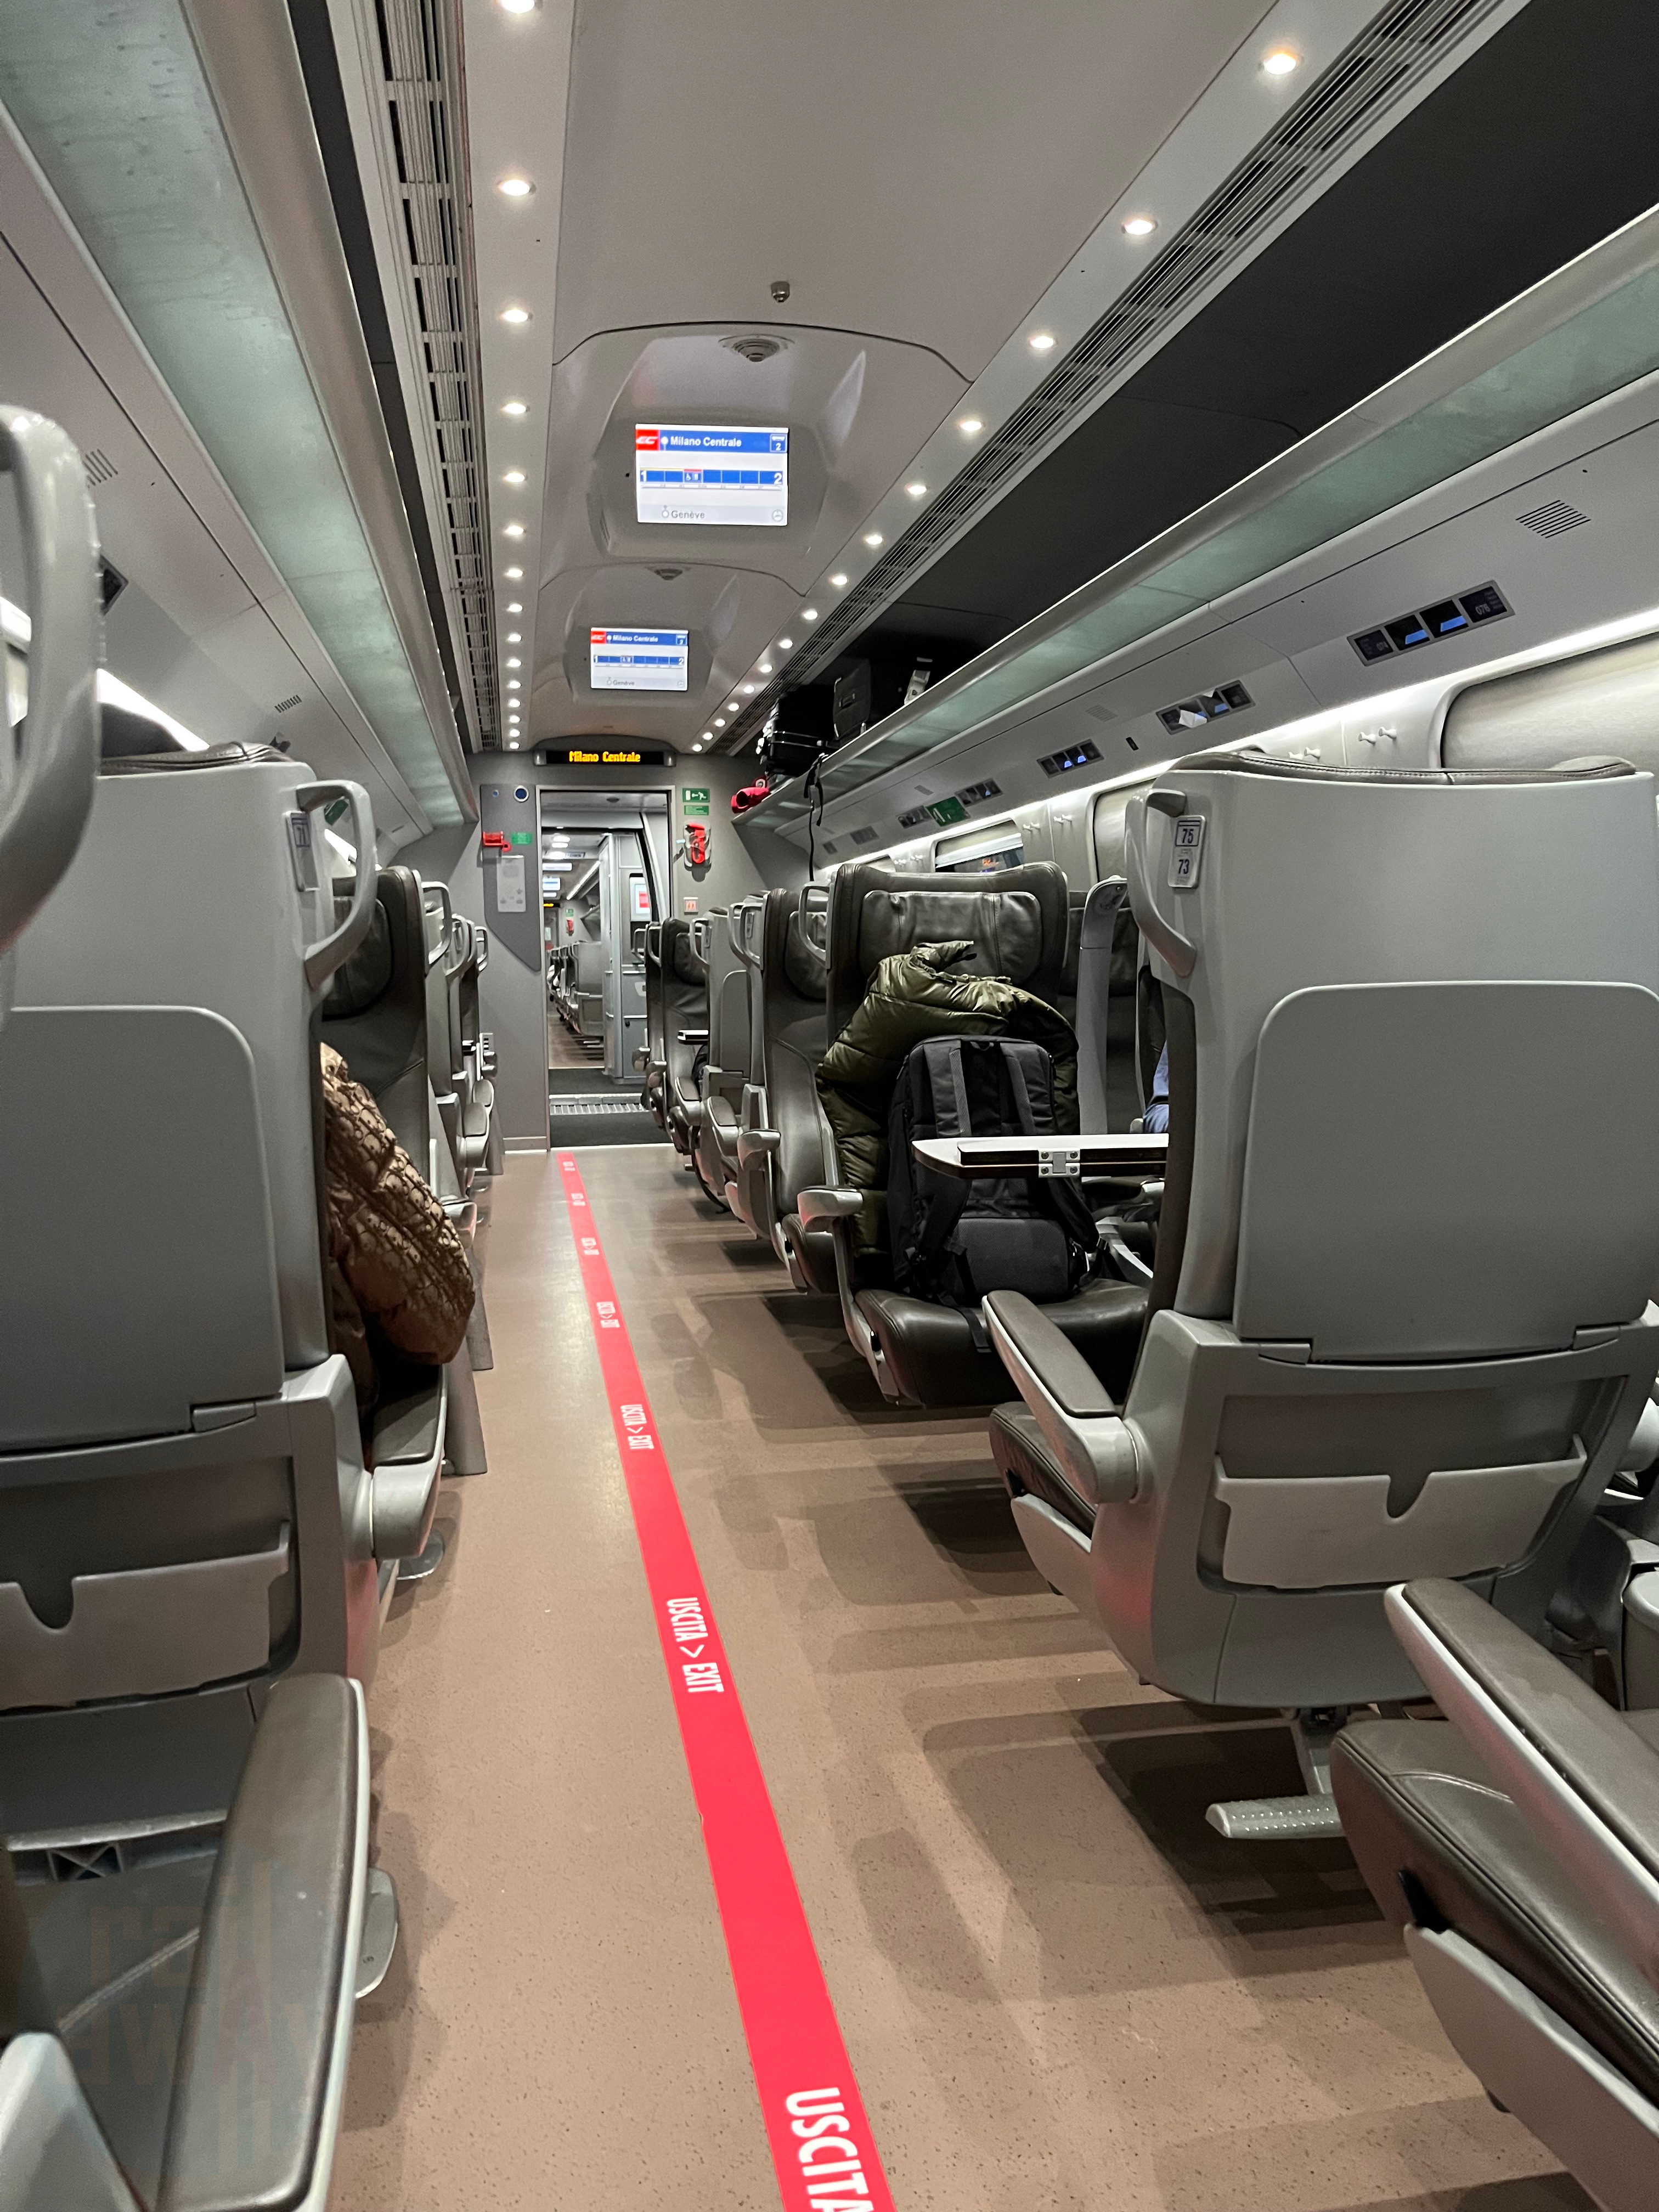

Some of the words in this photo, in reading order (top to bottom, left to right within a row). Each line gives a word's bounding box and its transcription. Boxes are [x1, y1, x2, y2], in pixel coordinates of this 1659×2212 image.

[670, 436, 701, 445] Milano
[703, 437, 742, 447] Centrale
[775, 442, 782, 451] 2
[641, 471, 647, 482] 1
[774, 472, 782, 485] 2
[671, 510, 705, 518] Genève
[679, 658, 685, 666] 2
[569, 751, 599, 762] Milano
[602, 751, 641, 762] Centrale
[1182, 828, 1194, 844] 75
[1178, 859, 1190, 874] 73
[667, 1597, 708, 1642] USCITA
[682, 1662, 725, 1692] EXIT
